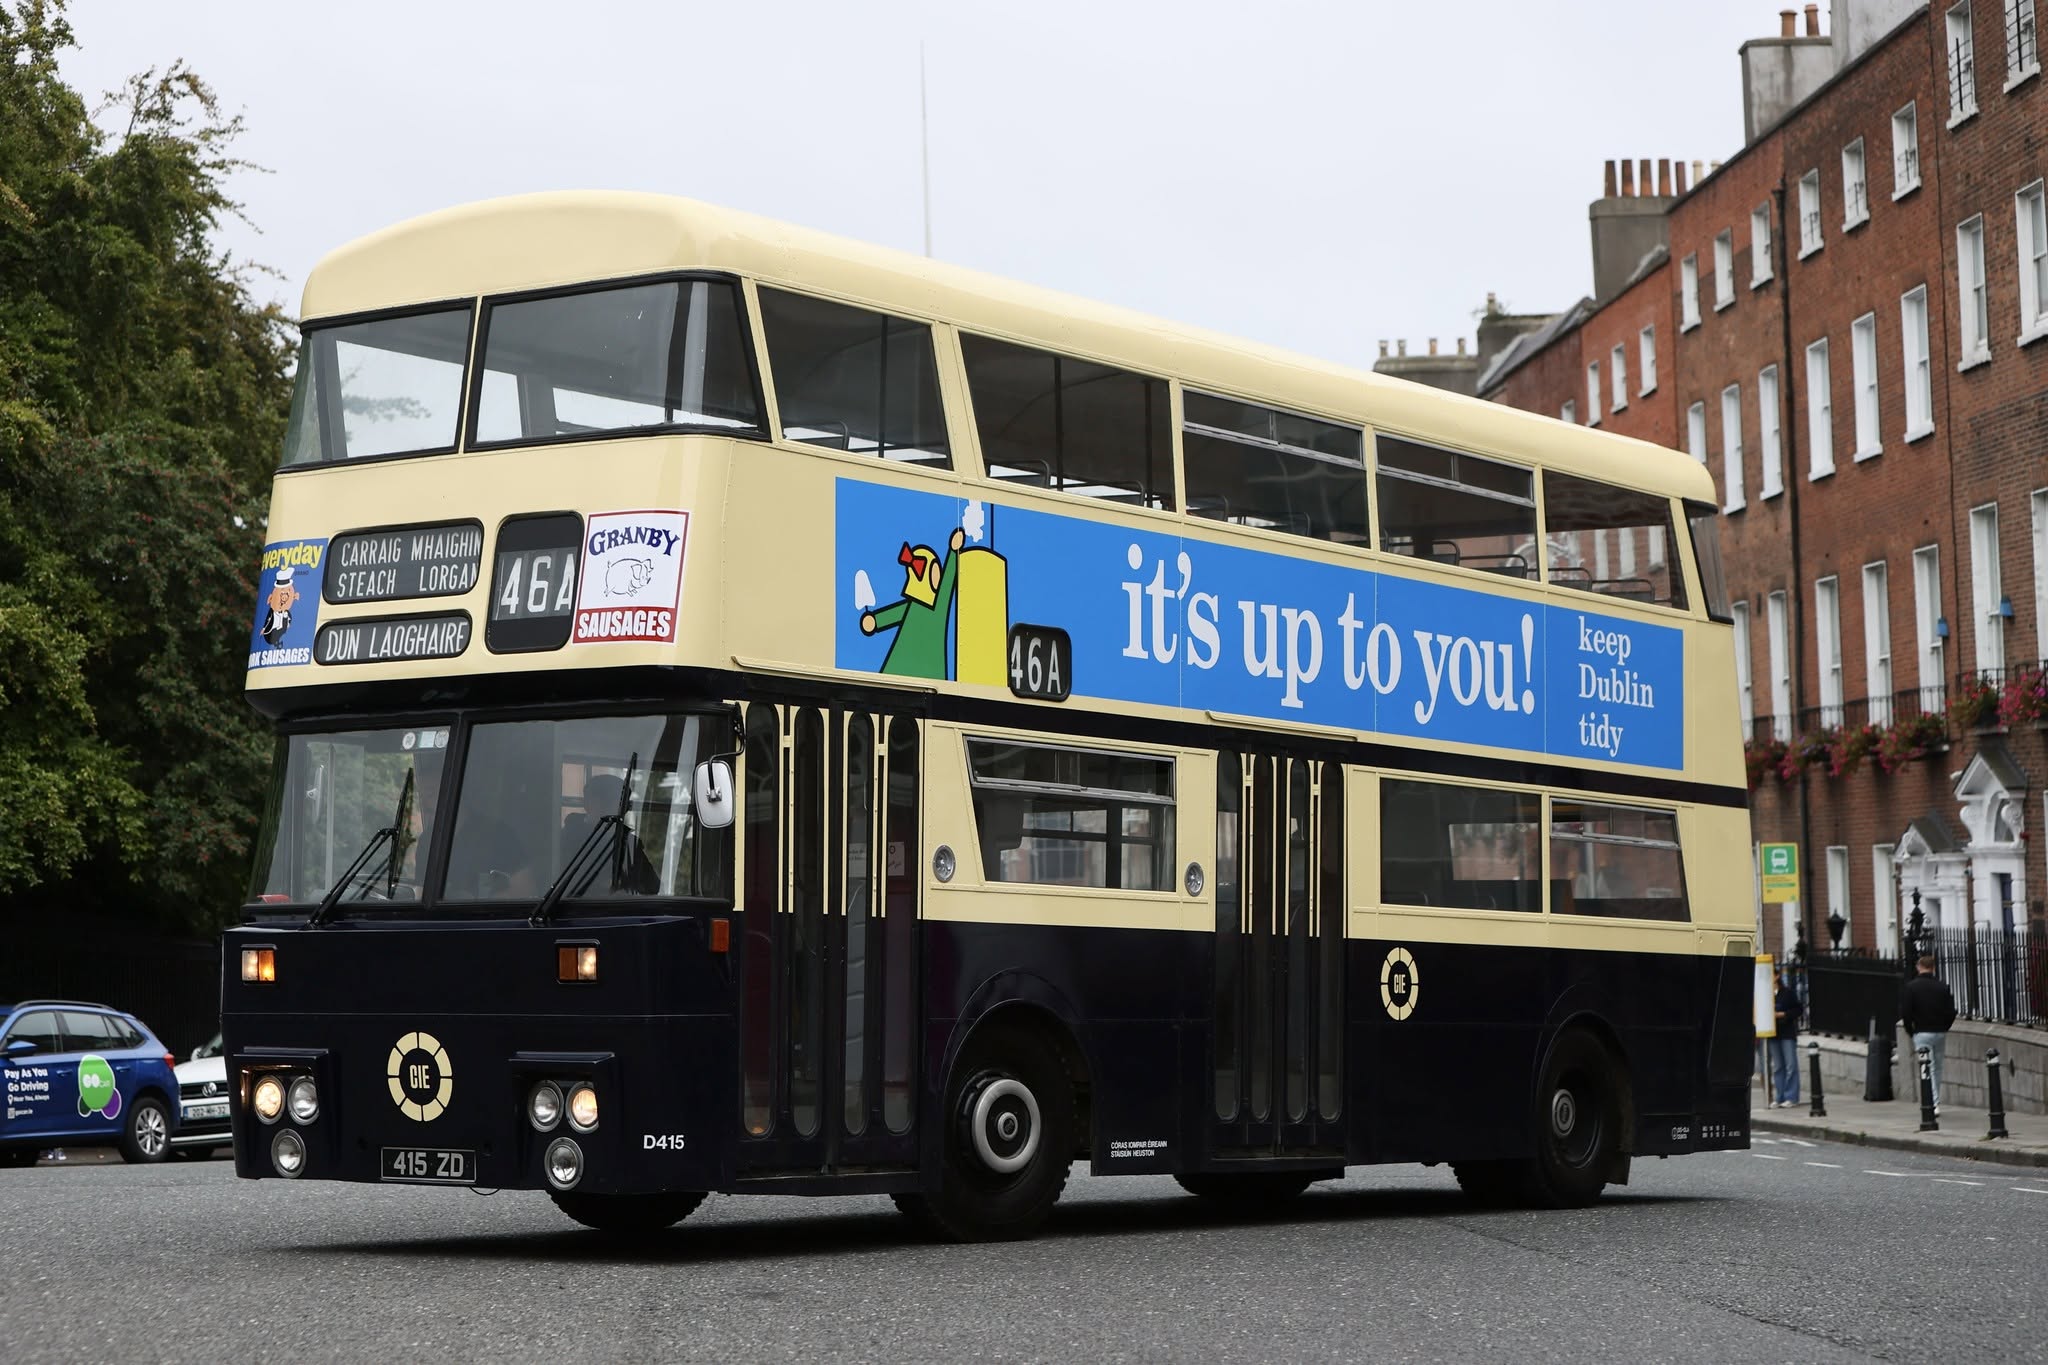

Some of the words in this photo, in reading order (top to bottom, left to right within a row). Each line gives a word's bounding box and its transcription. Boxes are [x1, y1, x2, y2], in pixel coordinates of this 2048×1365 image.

[341, 537, 402, 567] CARRAIG
[589, 526, 680, 556] GRANBY
[337, 568, 397, 598] STEACH
[500, 553, 576, 615] 46A
[577, 610, 671, 639] SAUSAGES
[1122, 543, 1221, 670] it’s
[1238, 600, 1323, 708] up
[1338, 592, 1402, 694] to
[1413, 613, 1535, 725] you!
[326, 629, 361, 662] DUN
[369, 622, 468, 659] LAOGHAIRE
[1578, 615, 1632, 666] keep
[261, 647, 310, 666] SAUSAGES
[1010, 635, 1061, 694] 46A
[1578, 663, 1655, 708] Dublin
[1578, 711, 1624, 758] tidy
[1393, 973, 1406, 994] CIE
[4, 1069, 20, 1080] Pay
[21, 1068, 32, 1078] As
[31, 1067, 48, 1077] You
[8, 1082, 19, 1092] Go
[20, 1080, 49, 1091] Driving
[409, 1064, 431, 1089] CIE
[643, 1134, 685, 1150] D415
[393, 1151, 428, 1176] 415
[436, 1152, 464, 1177] ZD
